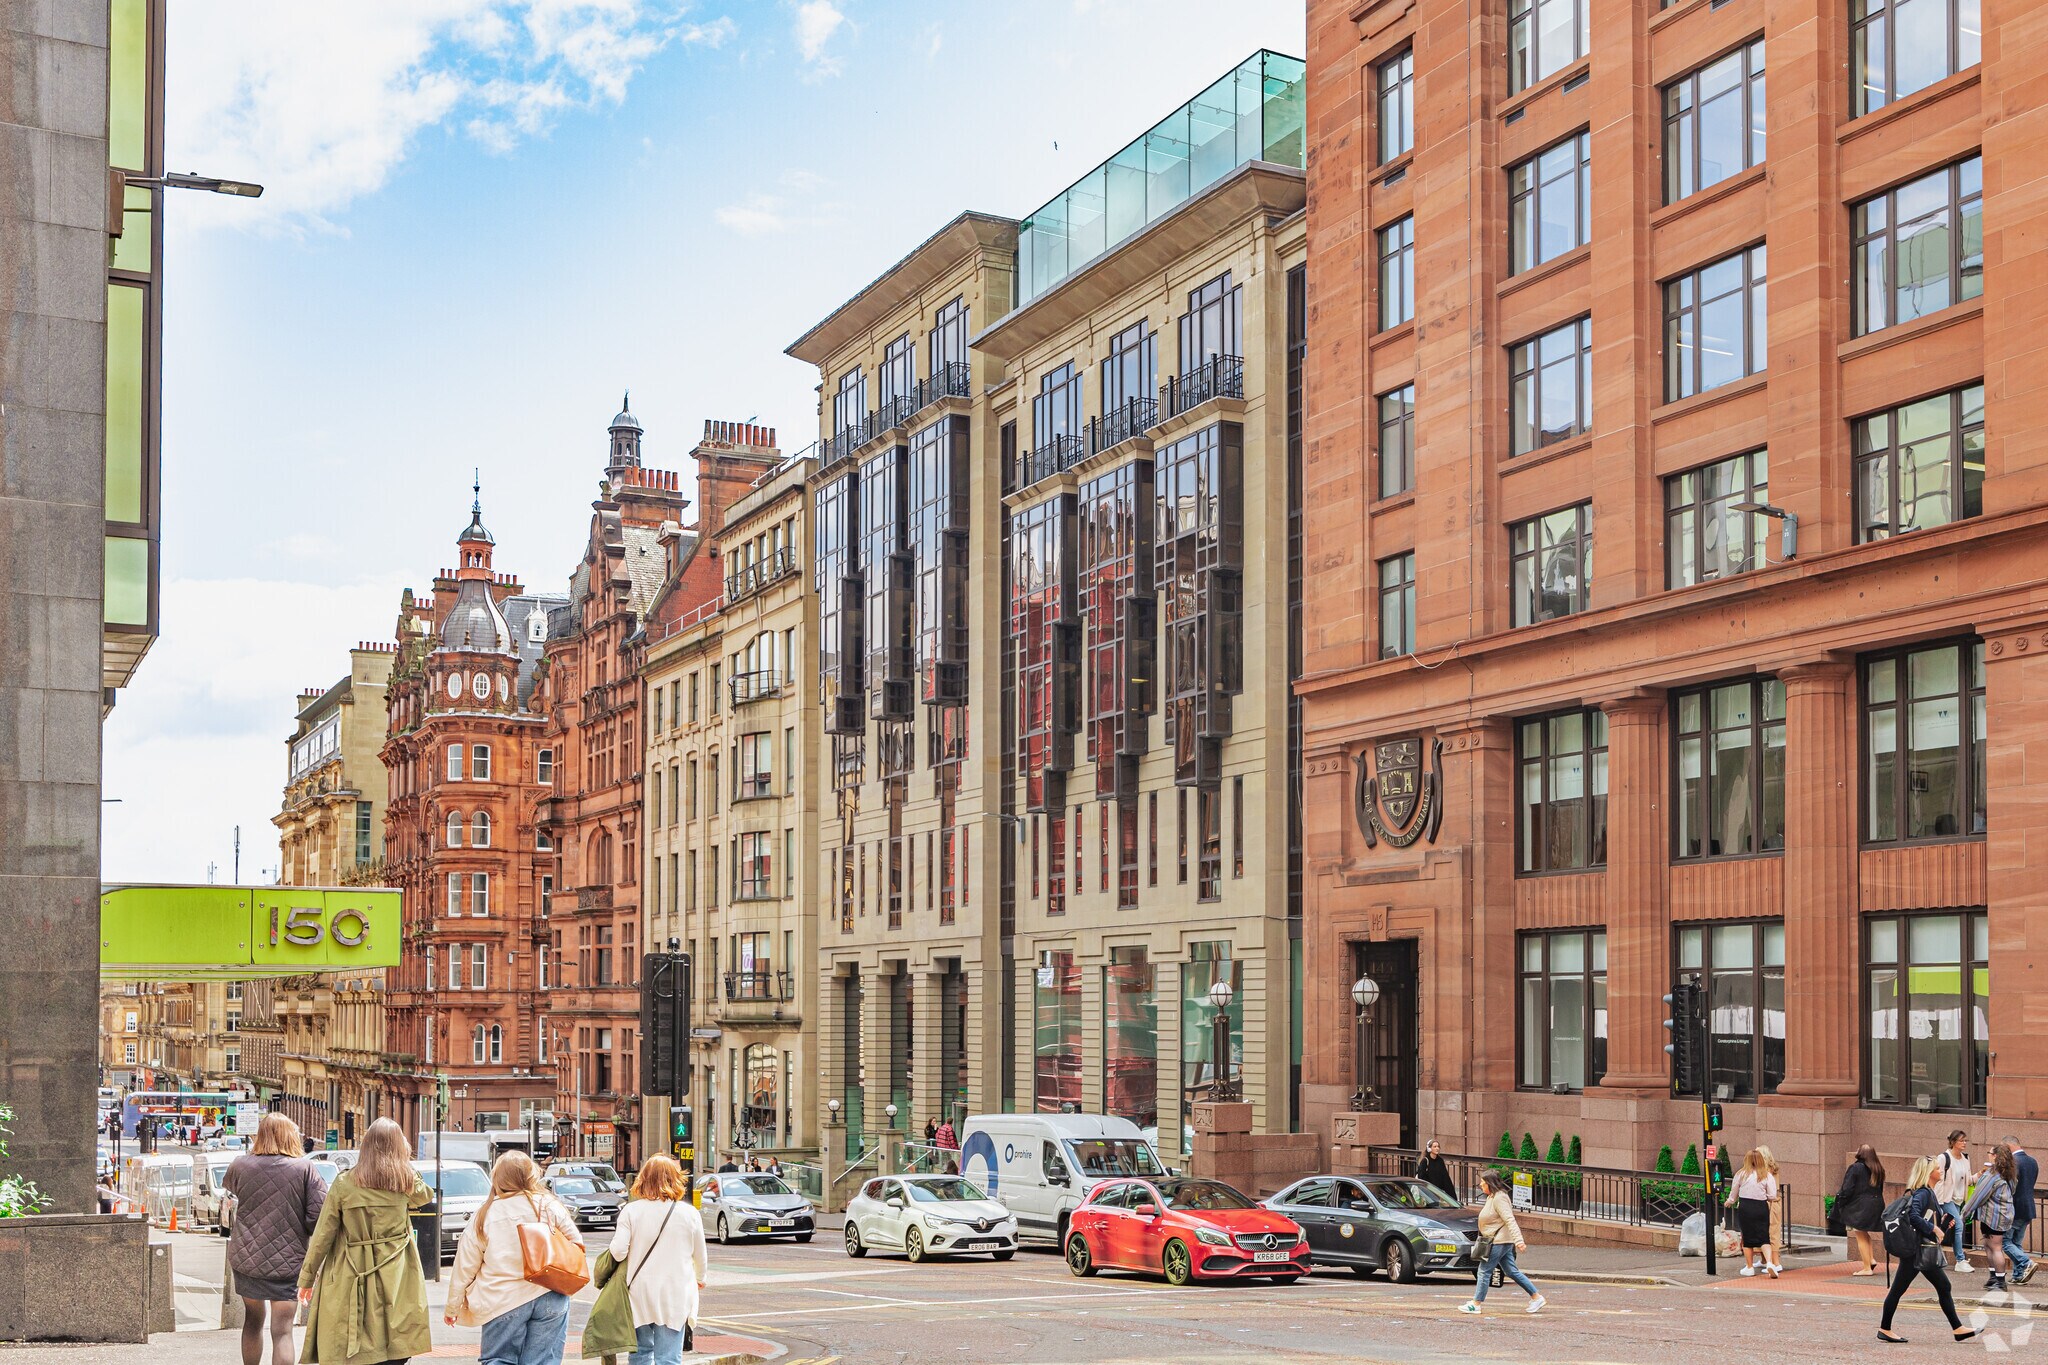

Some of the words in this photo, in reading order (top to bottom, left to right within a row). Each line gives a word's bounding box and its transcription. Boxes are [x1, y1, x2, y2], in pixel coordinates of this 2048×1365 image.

[1364, 794, 1373, 815] PER
[1397, 787, 1431, 845] PLACEBIMUS
[270, 906, 370, 947] 150
[599, 1135, 612, 1143] LET
[1014, 1149, 1032, 1160] prohire
[1256, 1253, 1275, 1261] KR68
[1275, 1252, 1287, 1260] GFE
[1491, 1267, 1501, 1286] DKNY
